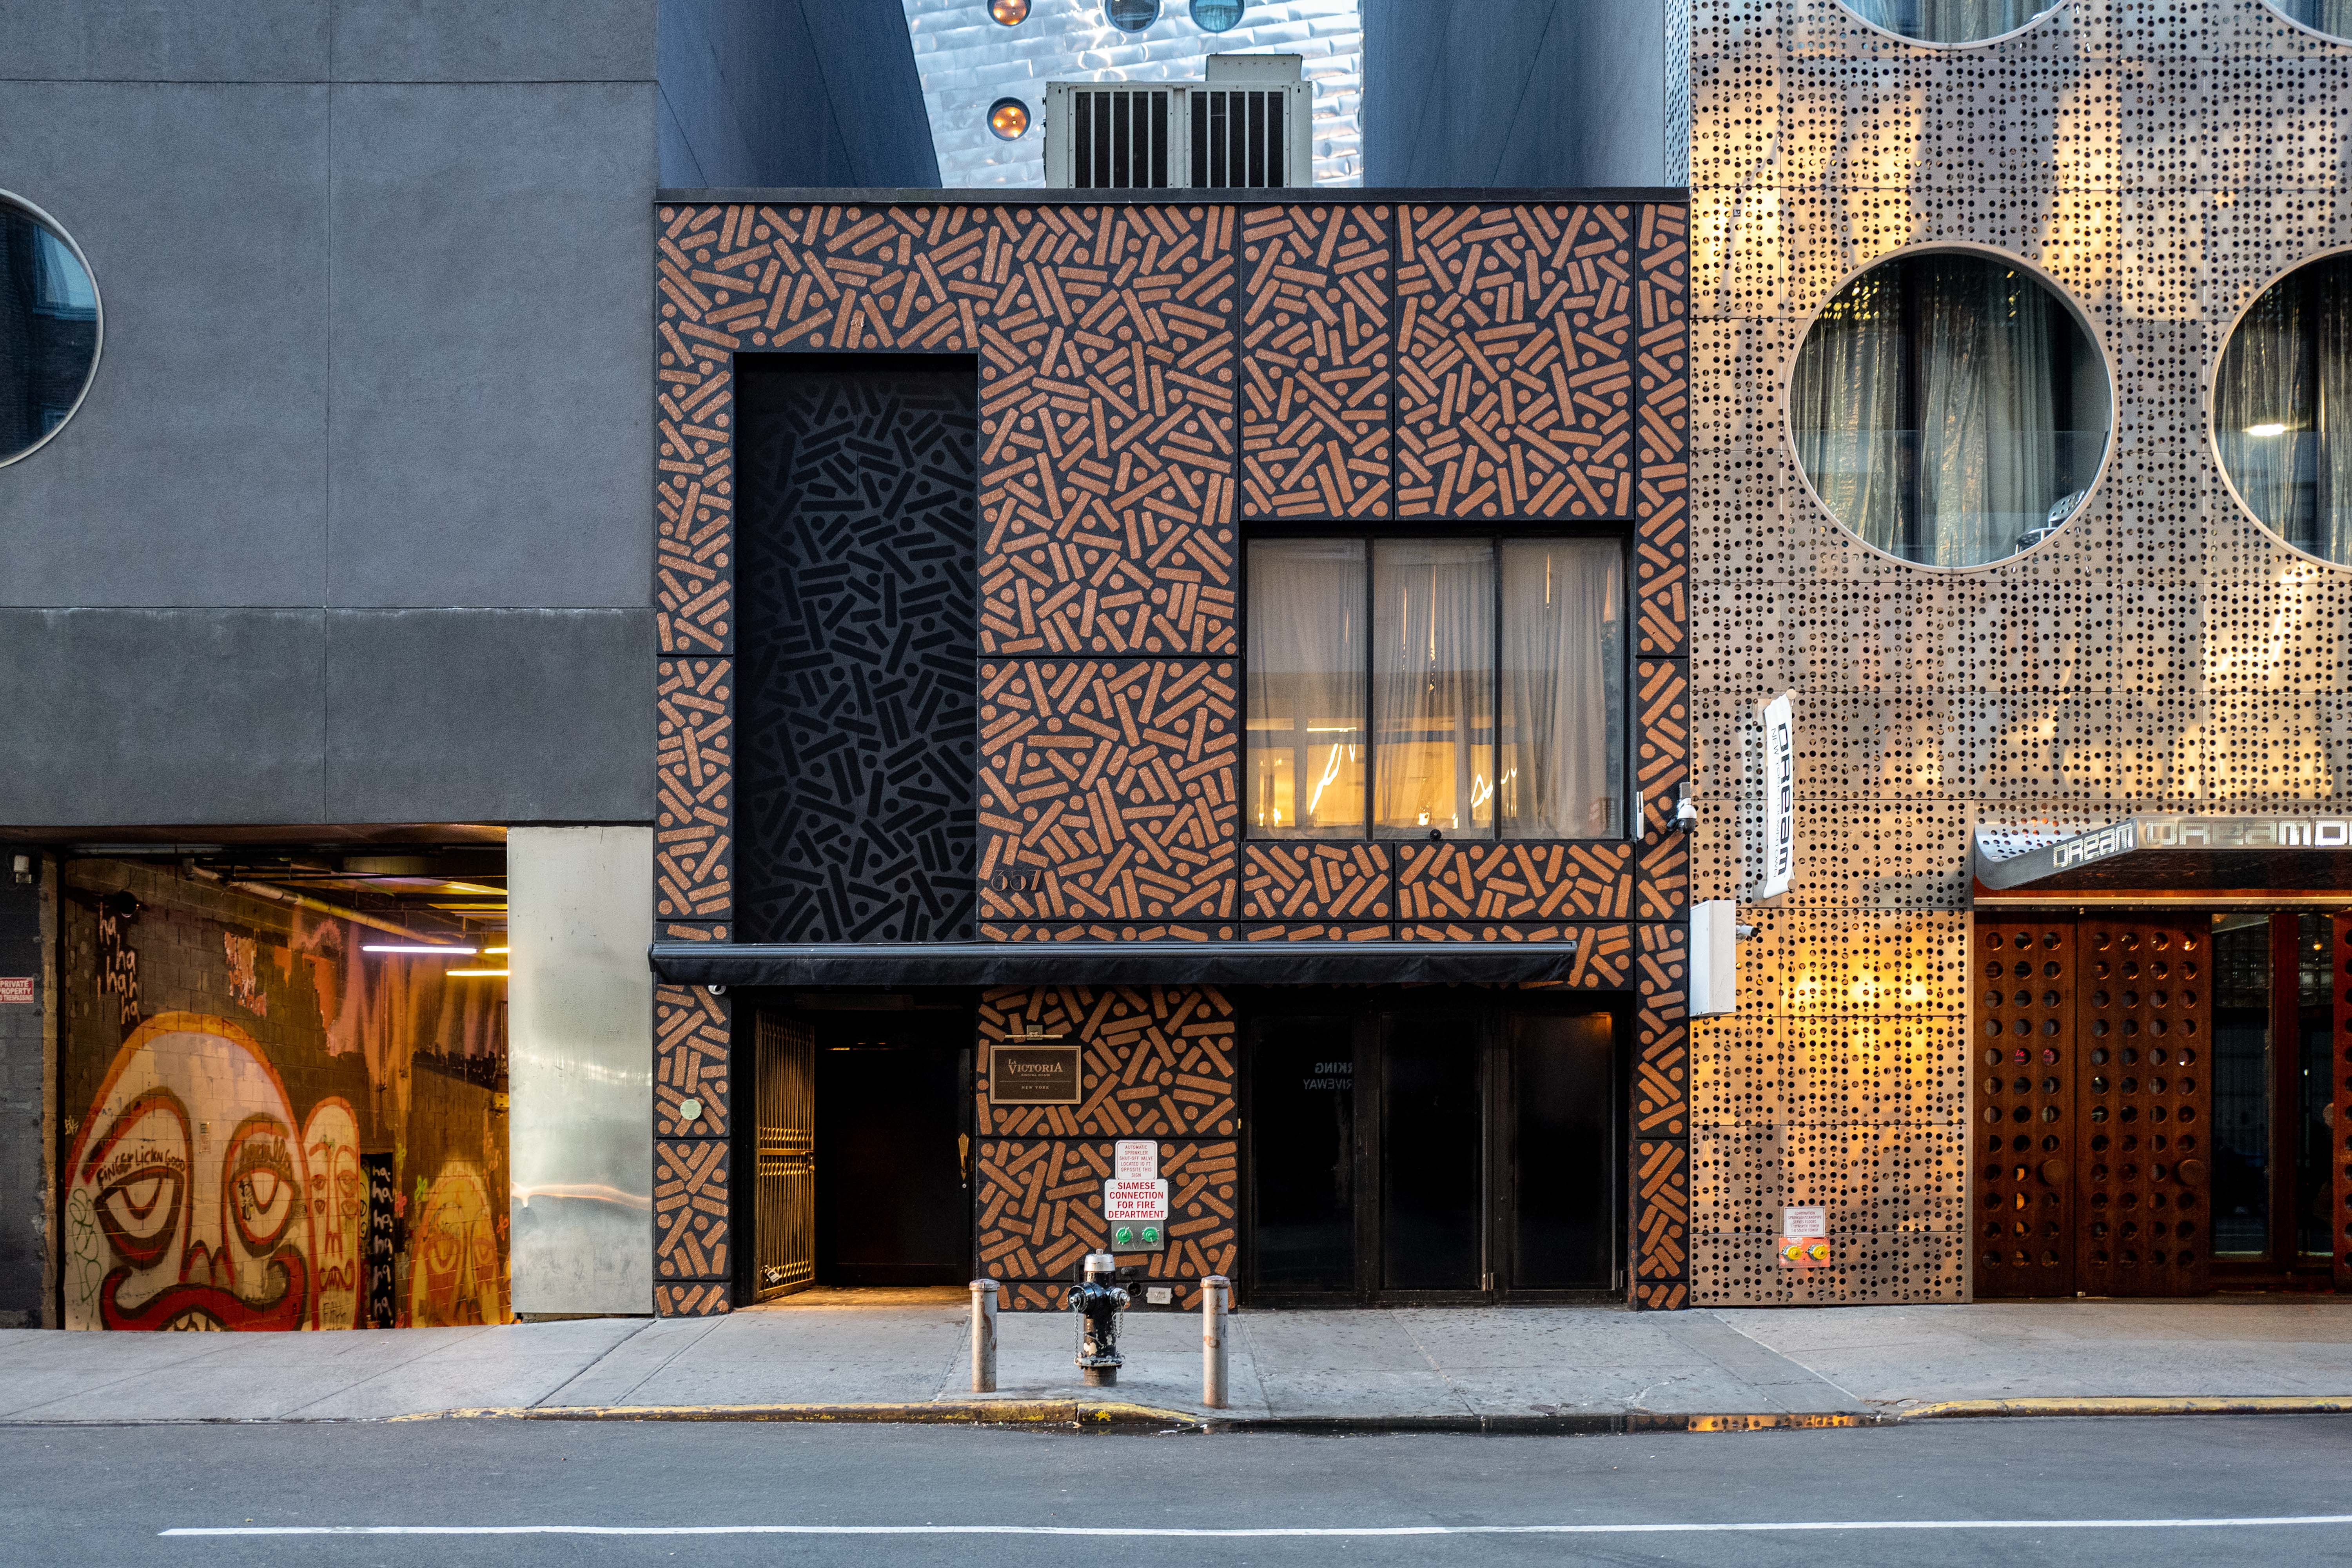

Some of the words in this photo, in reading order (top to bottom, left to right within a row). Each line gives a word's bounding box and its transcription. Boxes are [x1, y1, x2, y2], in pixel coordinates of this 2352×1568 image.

[100, 902, 116, 945] ha
[116, 934, 136, 975] ha
[1008, 1062, 1063, 1075] VICTORIA
